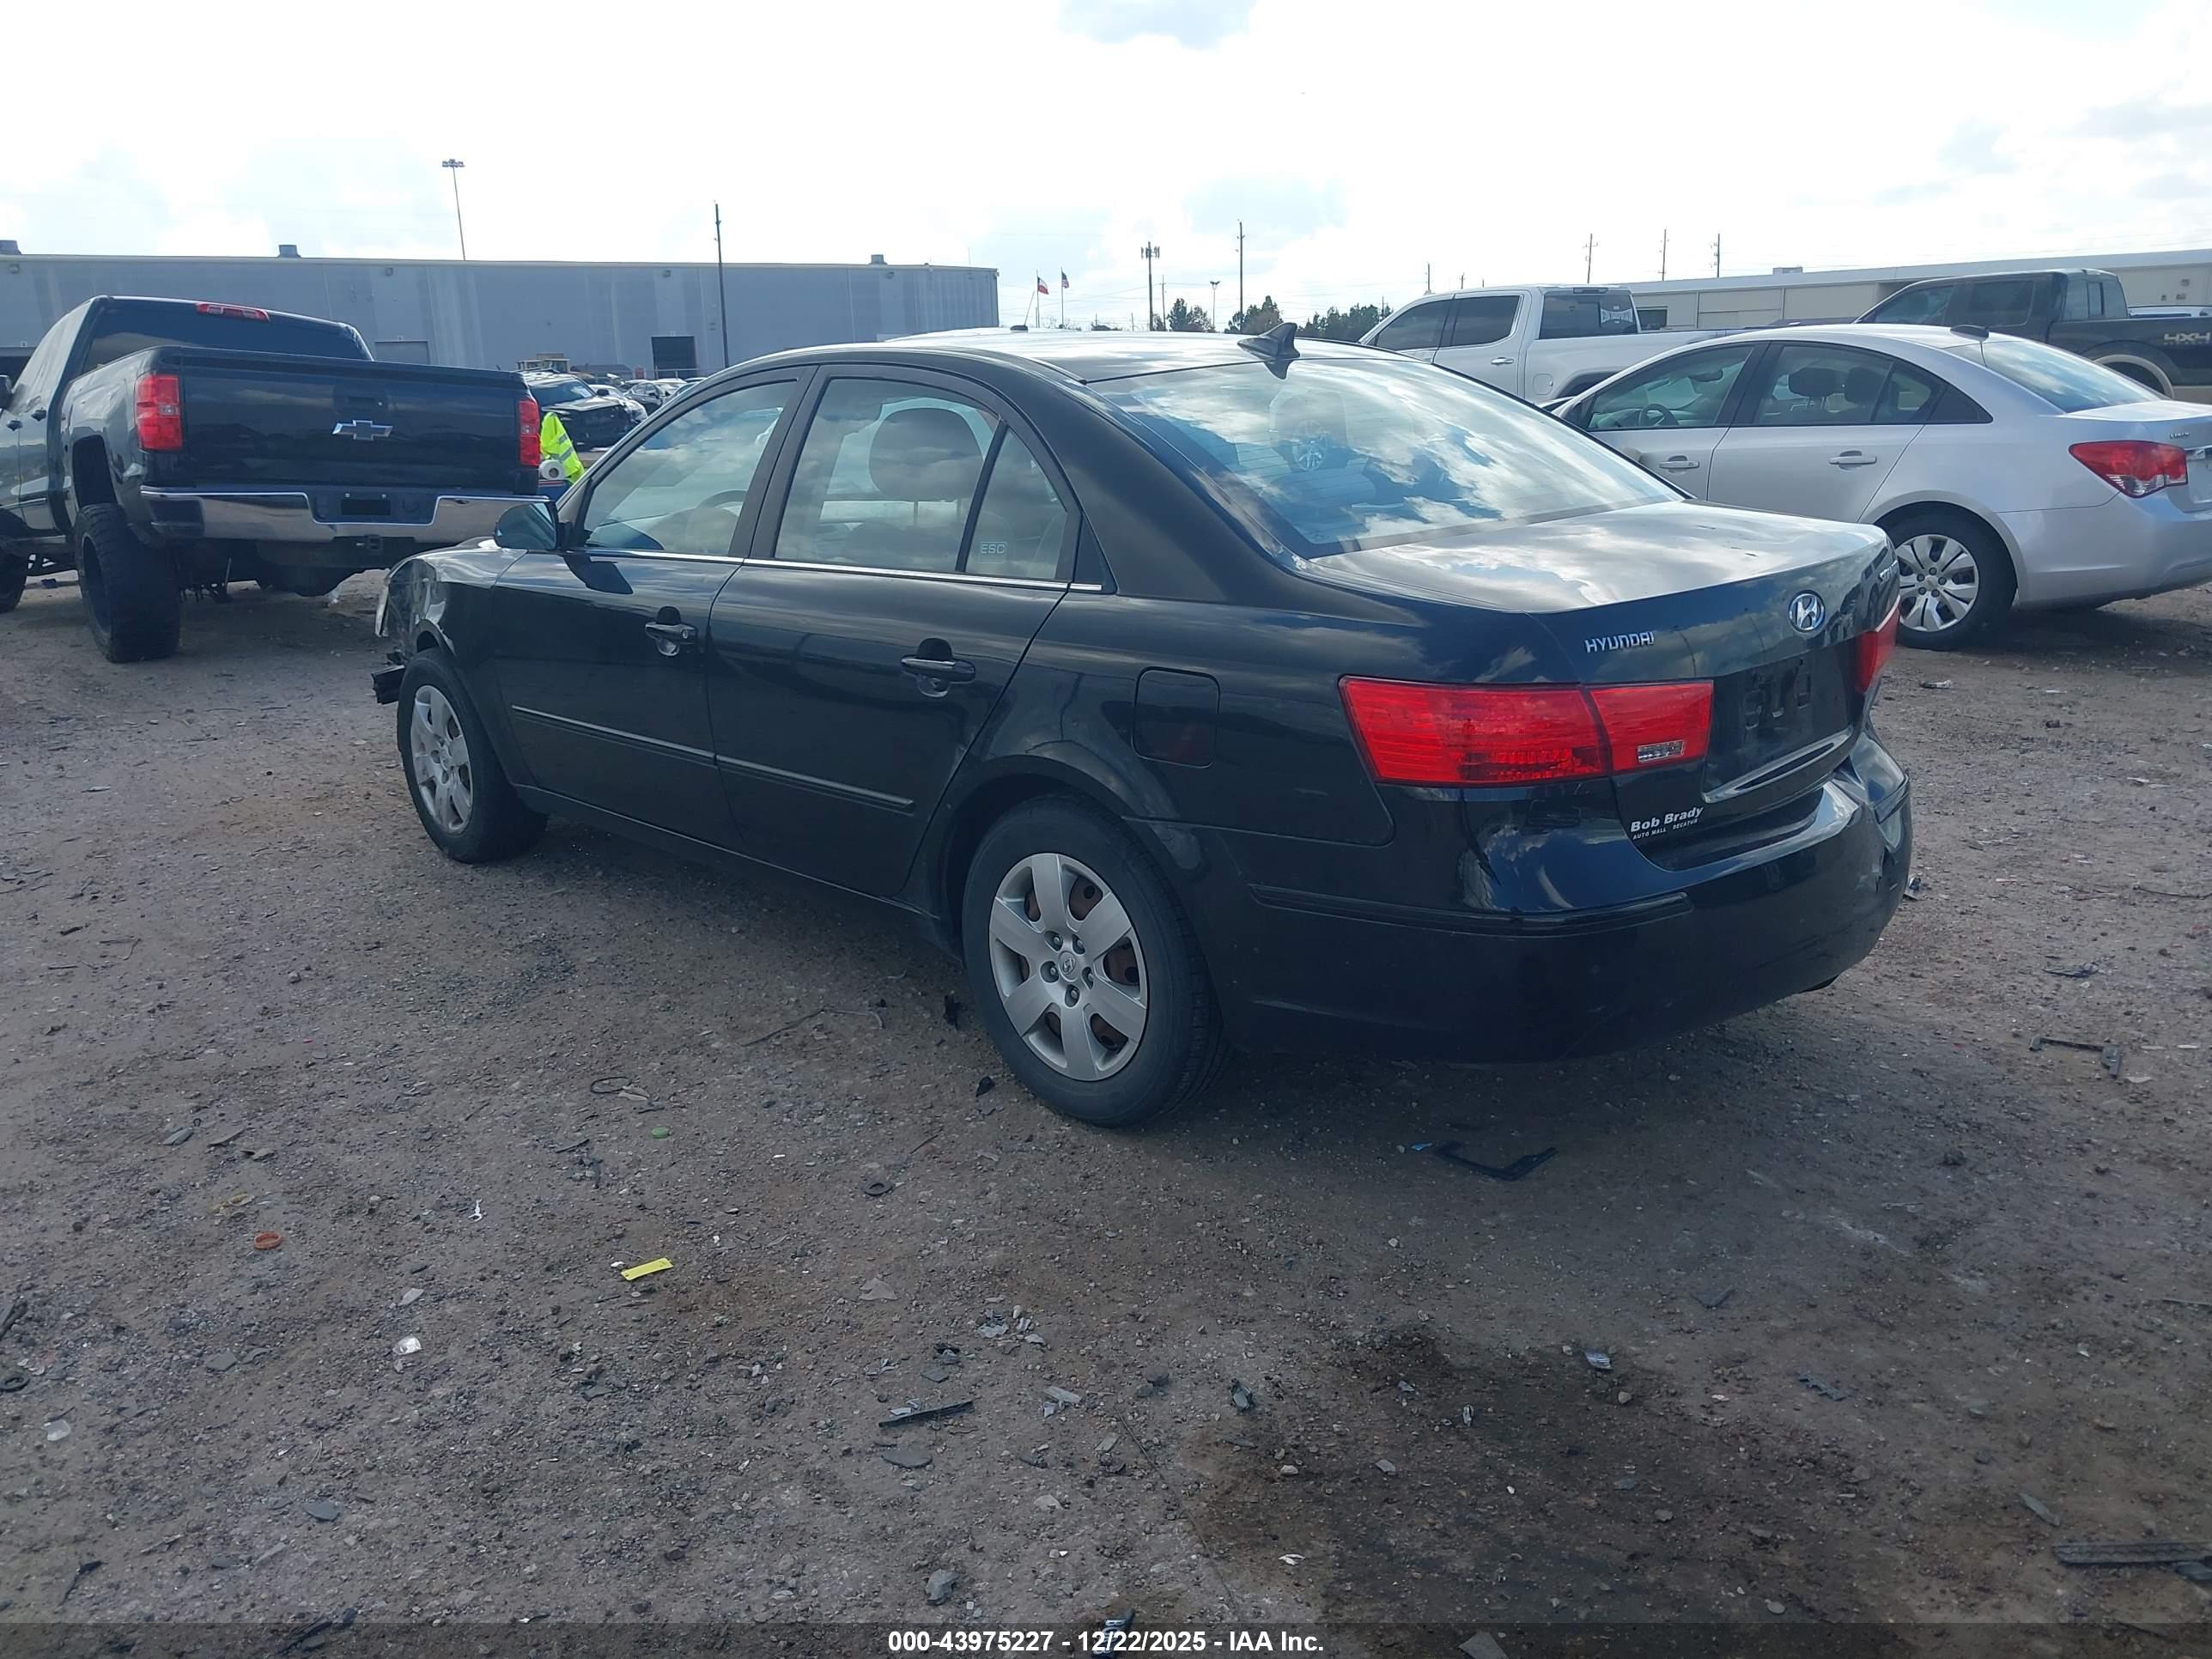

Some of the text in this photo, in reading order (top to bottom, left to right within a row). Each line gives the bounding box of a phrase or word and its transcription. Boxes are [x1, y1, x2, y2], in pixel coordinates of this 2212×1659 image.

[981, 544, 1005, 554] ESC
[1584, 631, 1655, 653] HYUNDAI
[1631, 806, 1704, 833] Bob Brady
[1632, 831, 1650, 840] AUTO
[1651, 827, 1667, 836] MALL
